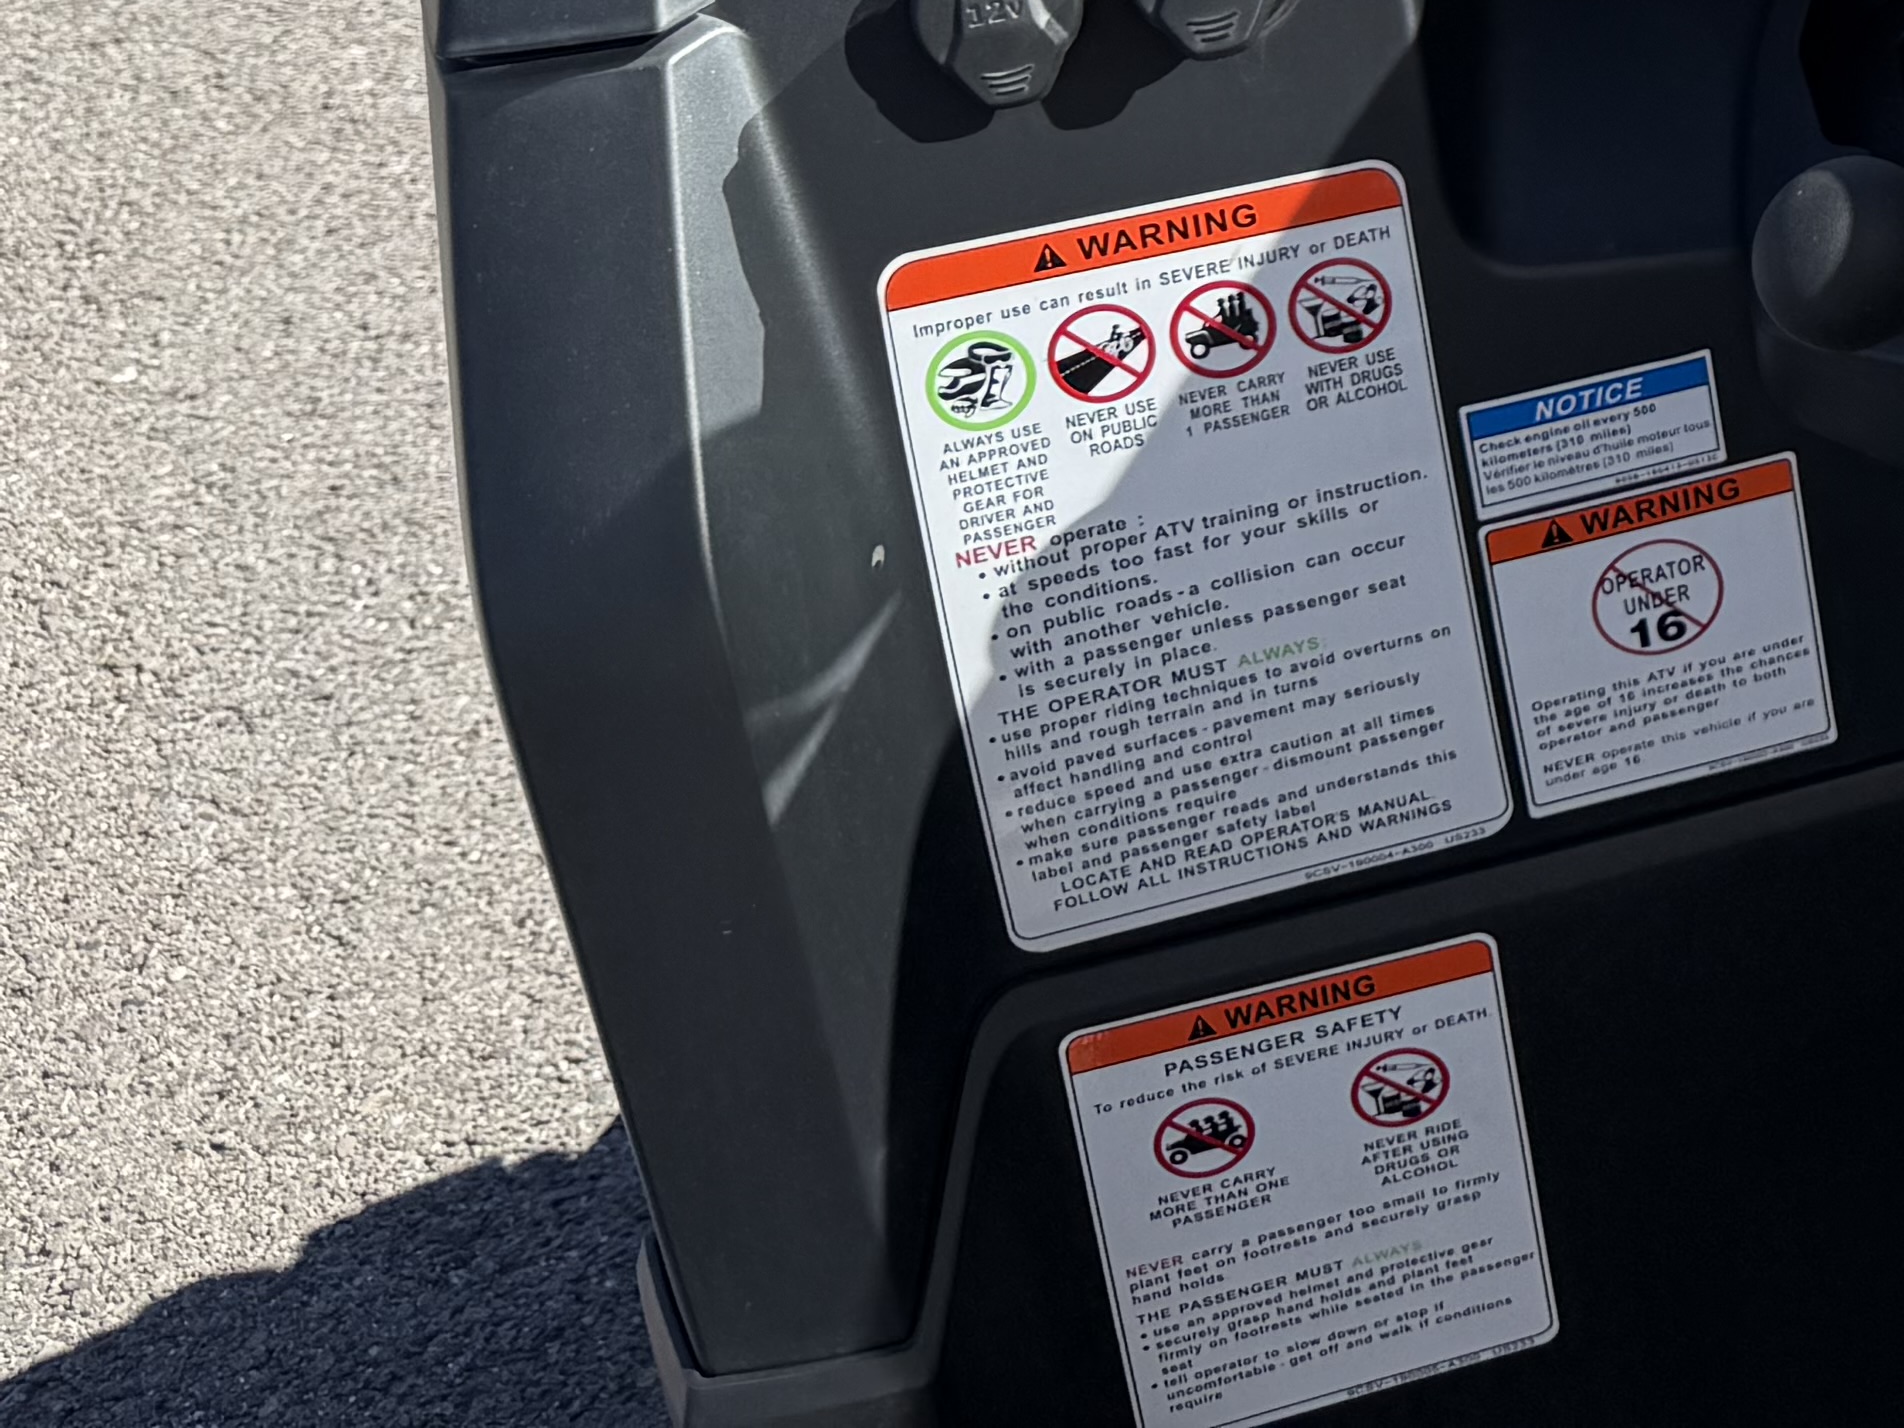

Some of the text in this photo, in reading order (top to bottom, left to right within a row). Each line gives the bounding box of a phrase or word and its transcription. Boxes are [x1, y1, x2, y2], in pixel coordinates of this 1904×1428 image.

[1077, 204, 1256, 259] WARNING
[912, 224, 1390, 338] Improper use can result in SEVERE INJURY or DEATH
[1303, 362, 1403, 396] WITH DRUGS
[1306, 346, 1396, 379] NEVER USE
[1177, 371, 1285, 406] NEVER CARRY
[1189, 389, 1280, 420] MORE THAN
[1305, 378, 1408, 411] OR ALCOHOL
[1535, 377, 1643, 421] NOTICE
[1064, 397, 1157, 429] NEVER USE
[1069, 413, 1157, 444] ON PUBLIC
[1185, 403, 1290, 437] 1 PASSENGER
[939, 436, 1051, 471] AN APPROVED
[942, 422, 1042, 454] ALWAYS USE
[1088, 432, 1144, 457] ROADS
[947, 452, 1048, 485] HELMET AND
[952, 468, 1049, 500] PROTECTIVE
[958, 499, 1054, 530] DRIVER AND
[962, 485, 1044, 513] GEAR FOR
[1580, 478, 1739, 535] WARNING
[962, 514, 1056, 545] PASSENGER
[992, 469, 1427, 577] without proper ATV training or instruction.
[954, 534, 1037, 568] NEVER
[1049, 518, 1127, 546] operate
[998, 499, 1379, 598] at speeds too fast for your skills or
[1600, 555, 1706, 595] OPERATOR
[1623, 585, 1690, 615] UNDER
[1009, 598, 1229, 659] with another vehicle.
[1629, 610, 1688, 648] 16
[996, 702, 1040, 726] THE
[1047, 673, 1163, 713] OPERATOR
[1170, 657, 1227, 685] MUST
[1052, 881, 1128, 912] FOLLOW
[1136, 872, 1171, 891] ALL
[1177, 835, 1309, 880] INSTRUCTIONS
[1316, 824, 1352, 845] AND
[1358, 798, 1452, 833] WARNINGS
[1059, 859, 1132, 893] LOCATE
[1139, 853, 1176, 874] AND
[1183, 838, 1233, 862] READ
[1239, 809, 1350, 847] OPERATOR'S
[1224, 975, 1375, 1028] WARNING
[1163, 1004, 1402, 1077] PASSENGER SAFETY
[1092, 1102, 1113, 1115] To
[1119, 1087, 1174, 1109] reduce
[1180, 1079, 1206, 1093] the
[1213, 1068, 1244, 1085] risk
[1250, 1061, 1266, 1076] of
[1273, 1043, 1339, 1070] SEVERE
[1345, 1027, 1404, 1052] INJURY
[1411, 1023, 1427, 1035] or
